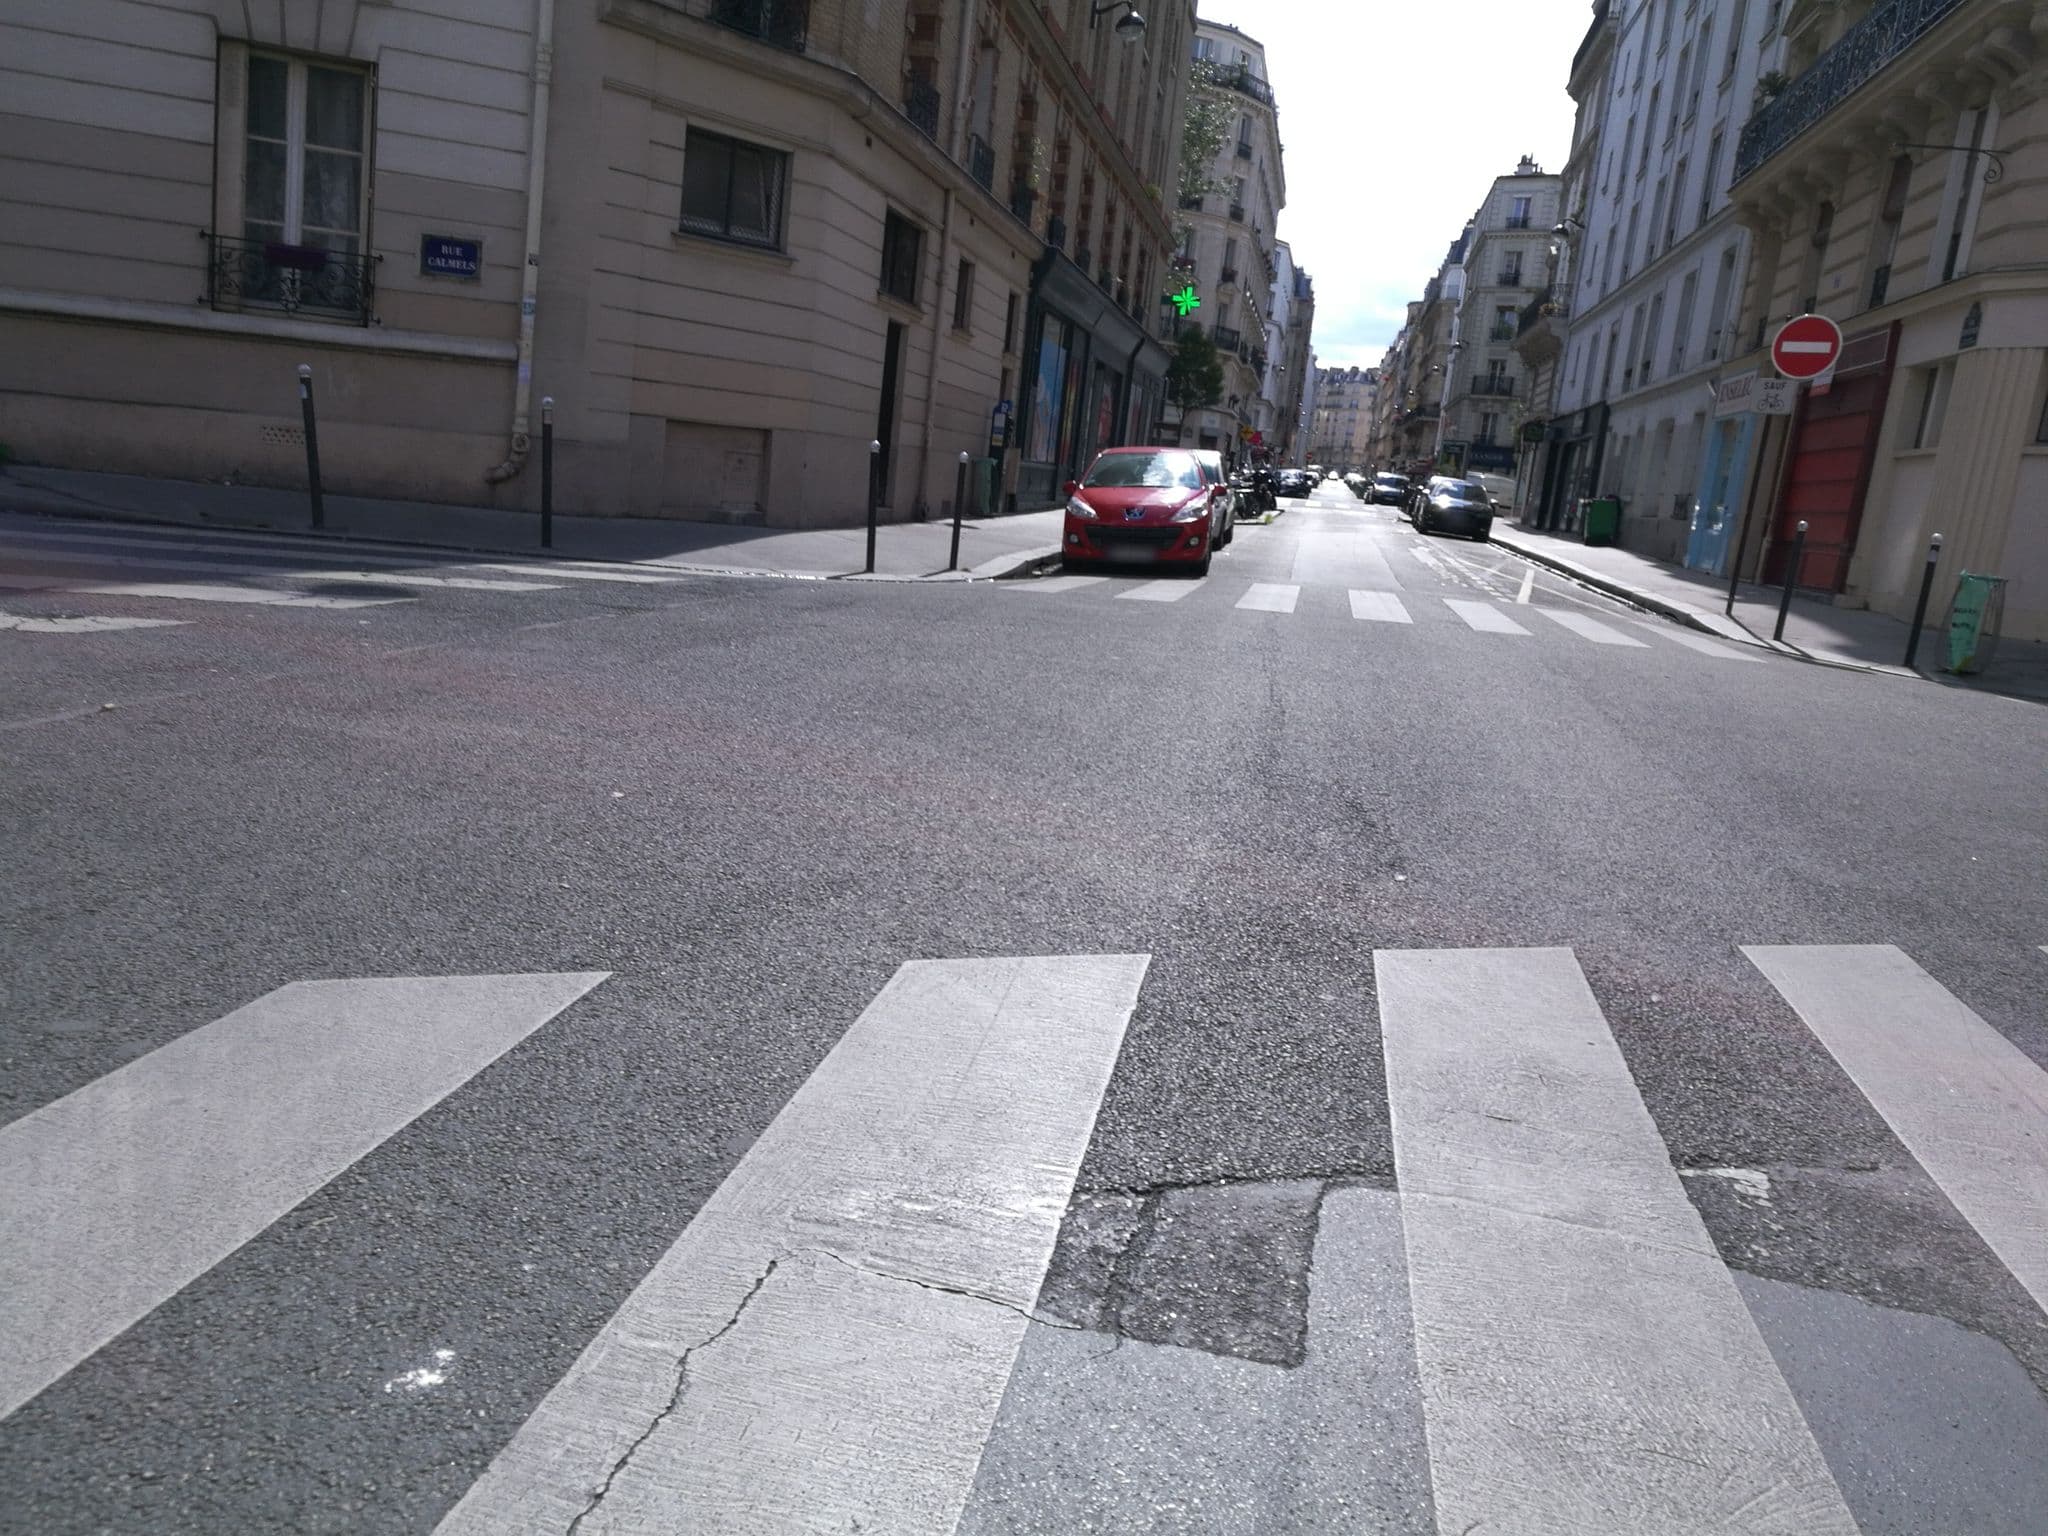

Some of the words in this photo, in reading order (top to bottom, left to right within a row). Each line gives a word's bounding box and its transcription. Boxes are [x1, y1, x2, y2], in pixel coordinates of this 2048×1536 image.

[441, 244, 464, 257] RUE
[427, 256, 477, 271] CALMELS
[1763, 382, 1787, 391] SAUF
